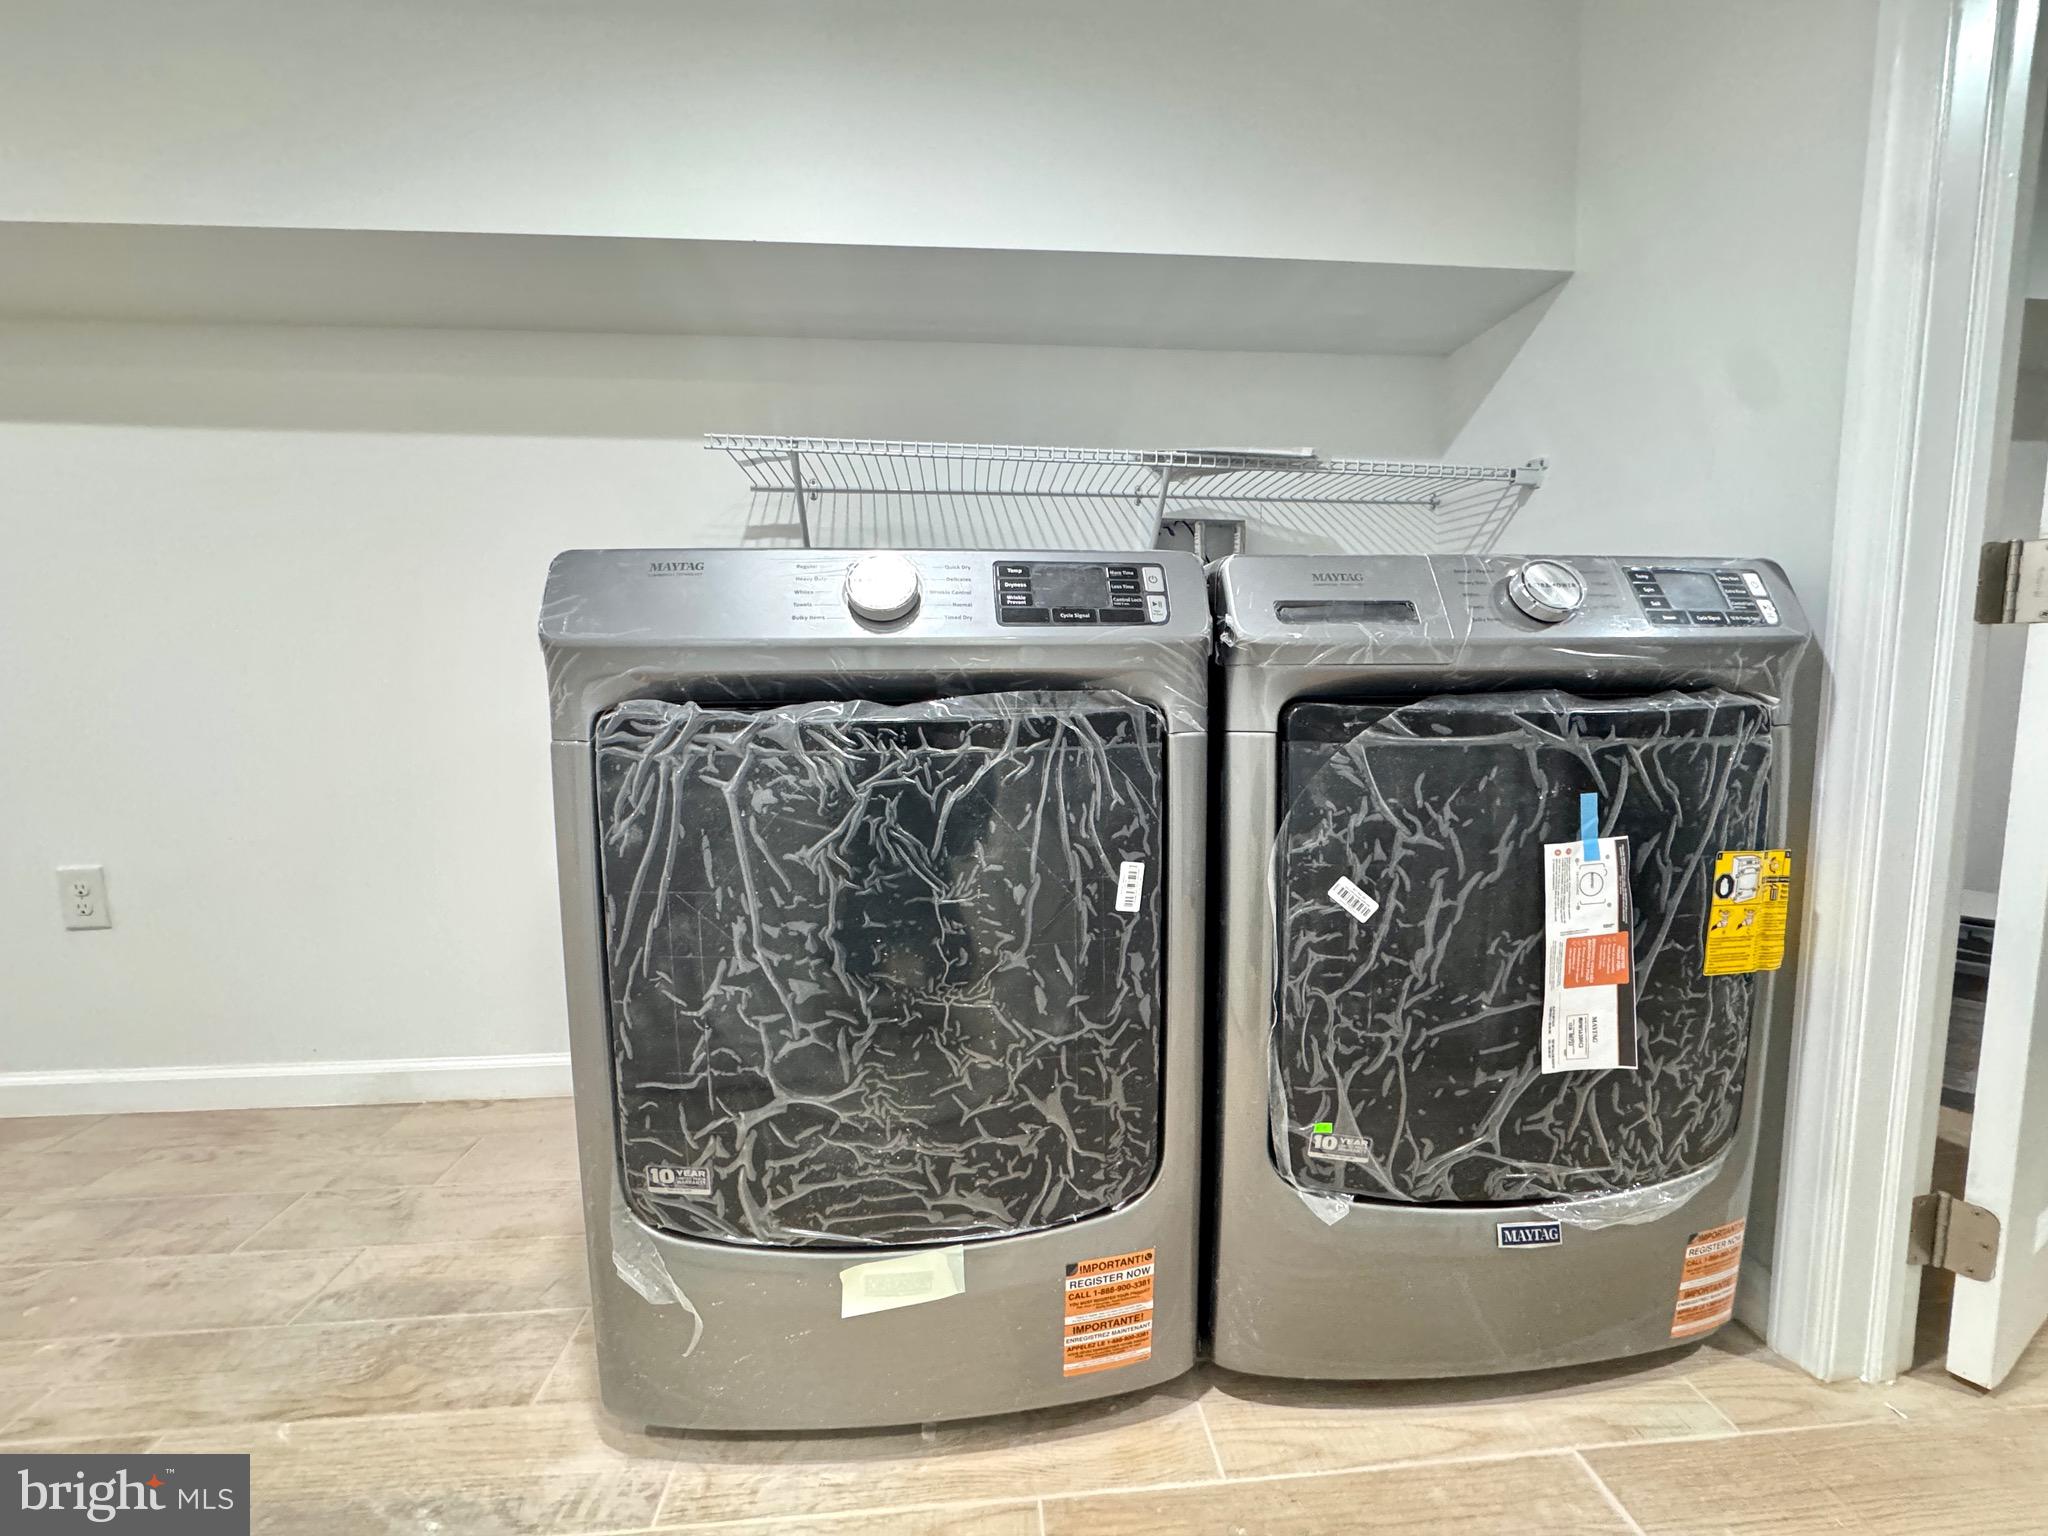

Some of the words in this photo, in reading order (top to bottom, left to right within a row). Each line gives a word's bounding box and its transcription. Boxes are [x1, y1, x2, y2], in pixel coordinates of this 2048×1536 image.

[649, 562, 704, 572] MAYTAG
[1004, 581, 1027, 589] Dryness
[1311, 572, 1364, 582] MAYTAG
[1060, 612, 1074, 620] Cycle
[1074, 612, 1090, 620] Signal
[1313, 1134, 1338, 1151] 10
[650, 1168, 675, 1184] 10
[675, 1169, 706, 1177] YEAR
[1503, 1227, 1559, 1243] MAYTAG
[1688, 1240, 1725, 1256] REGISTER
[1079, 1254, 1145, 1275] IMPORTANT!
[1069, 1272, 1124, 1290] REGISTER
[1126, 1266, 1151, 1280] NOW
[1068, 1291, 1091, 1301] CALL
[1072, 1312, 1145, 1335] IMPORTANTE!
[1066, 1331, 1111, 1344] ENREGISTREZ
[1111, 1322, 1151, 1336] MAINTENANT
[1066, 1343, 1096, 1353] APPELEZ
